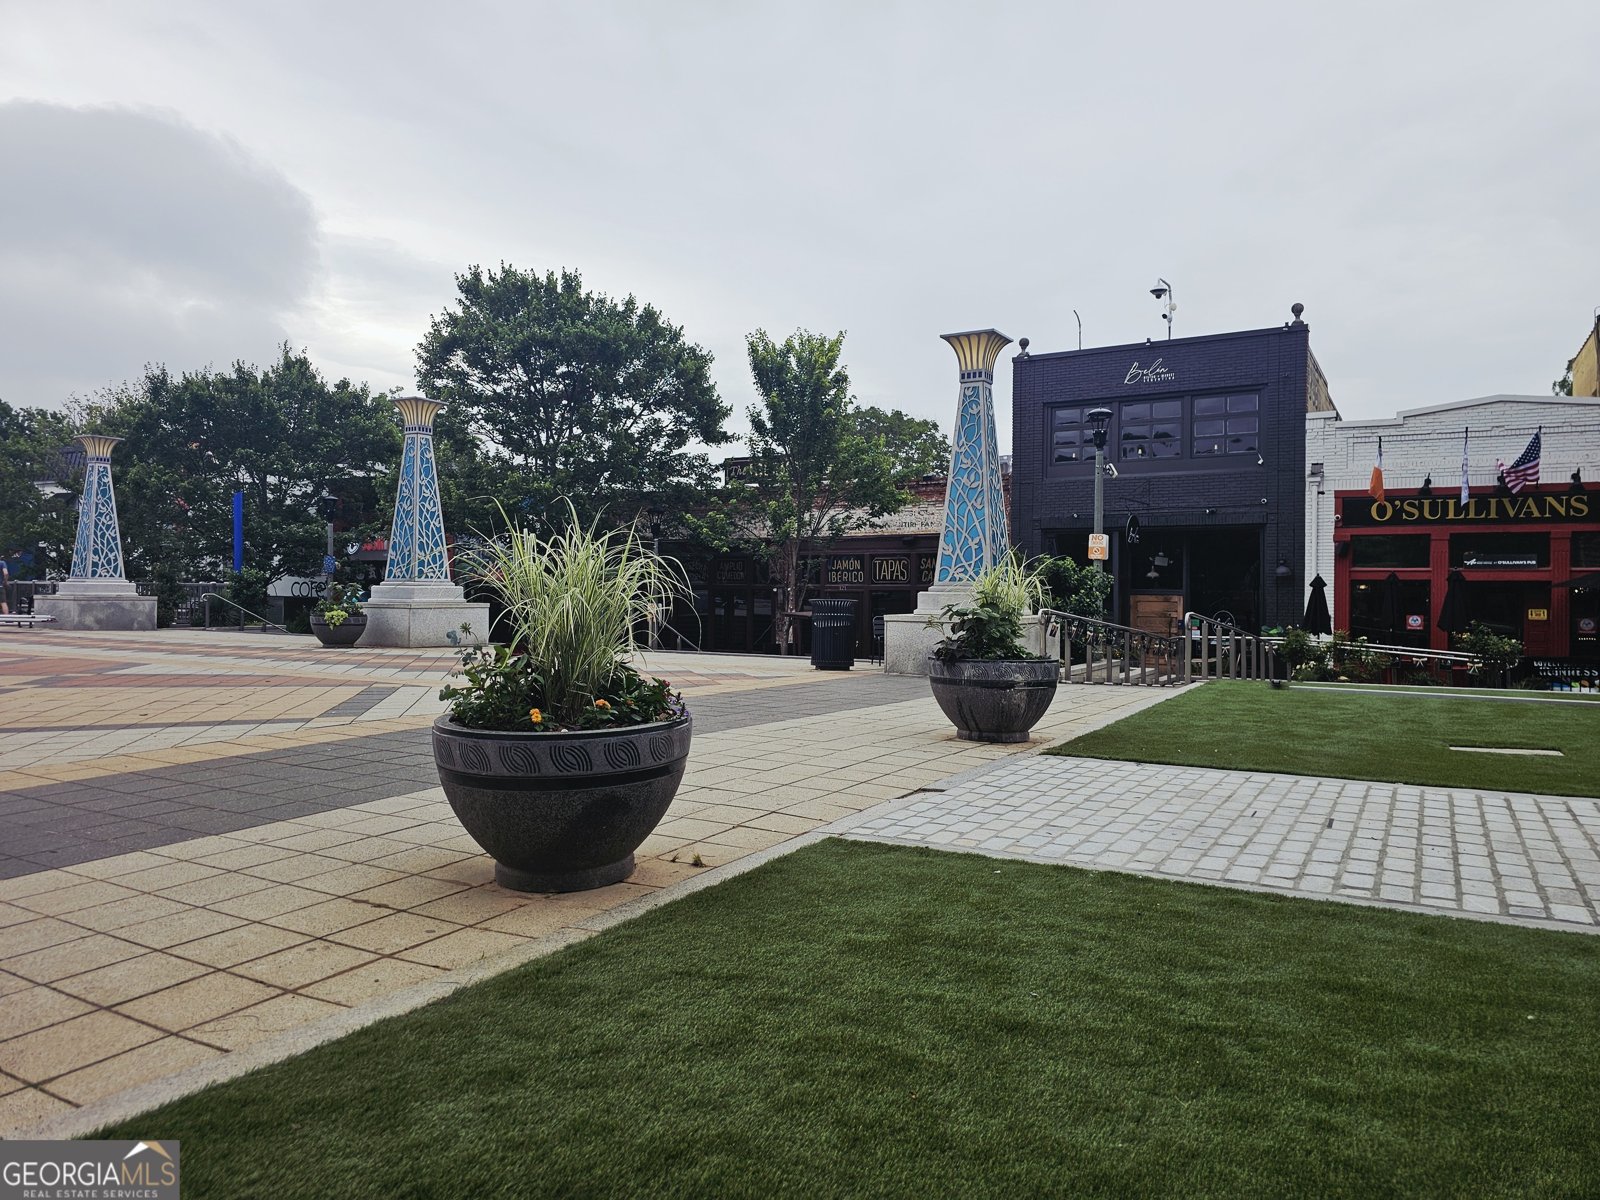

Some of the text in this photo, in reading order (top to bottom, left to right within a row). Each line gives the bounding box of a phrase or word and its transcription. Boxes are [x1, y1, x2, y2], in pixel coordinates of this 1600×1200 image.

[1370, 495, 1590, 521] O'SULLIVANS
[1091, 534, 1104, 542] NO
[832, 558, 861, 570] JAMÓN
[874, 560, 908, 581] TAPAS
